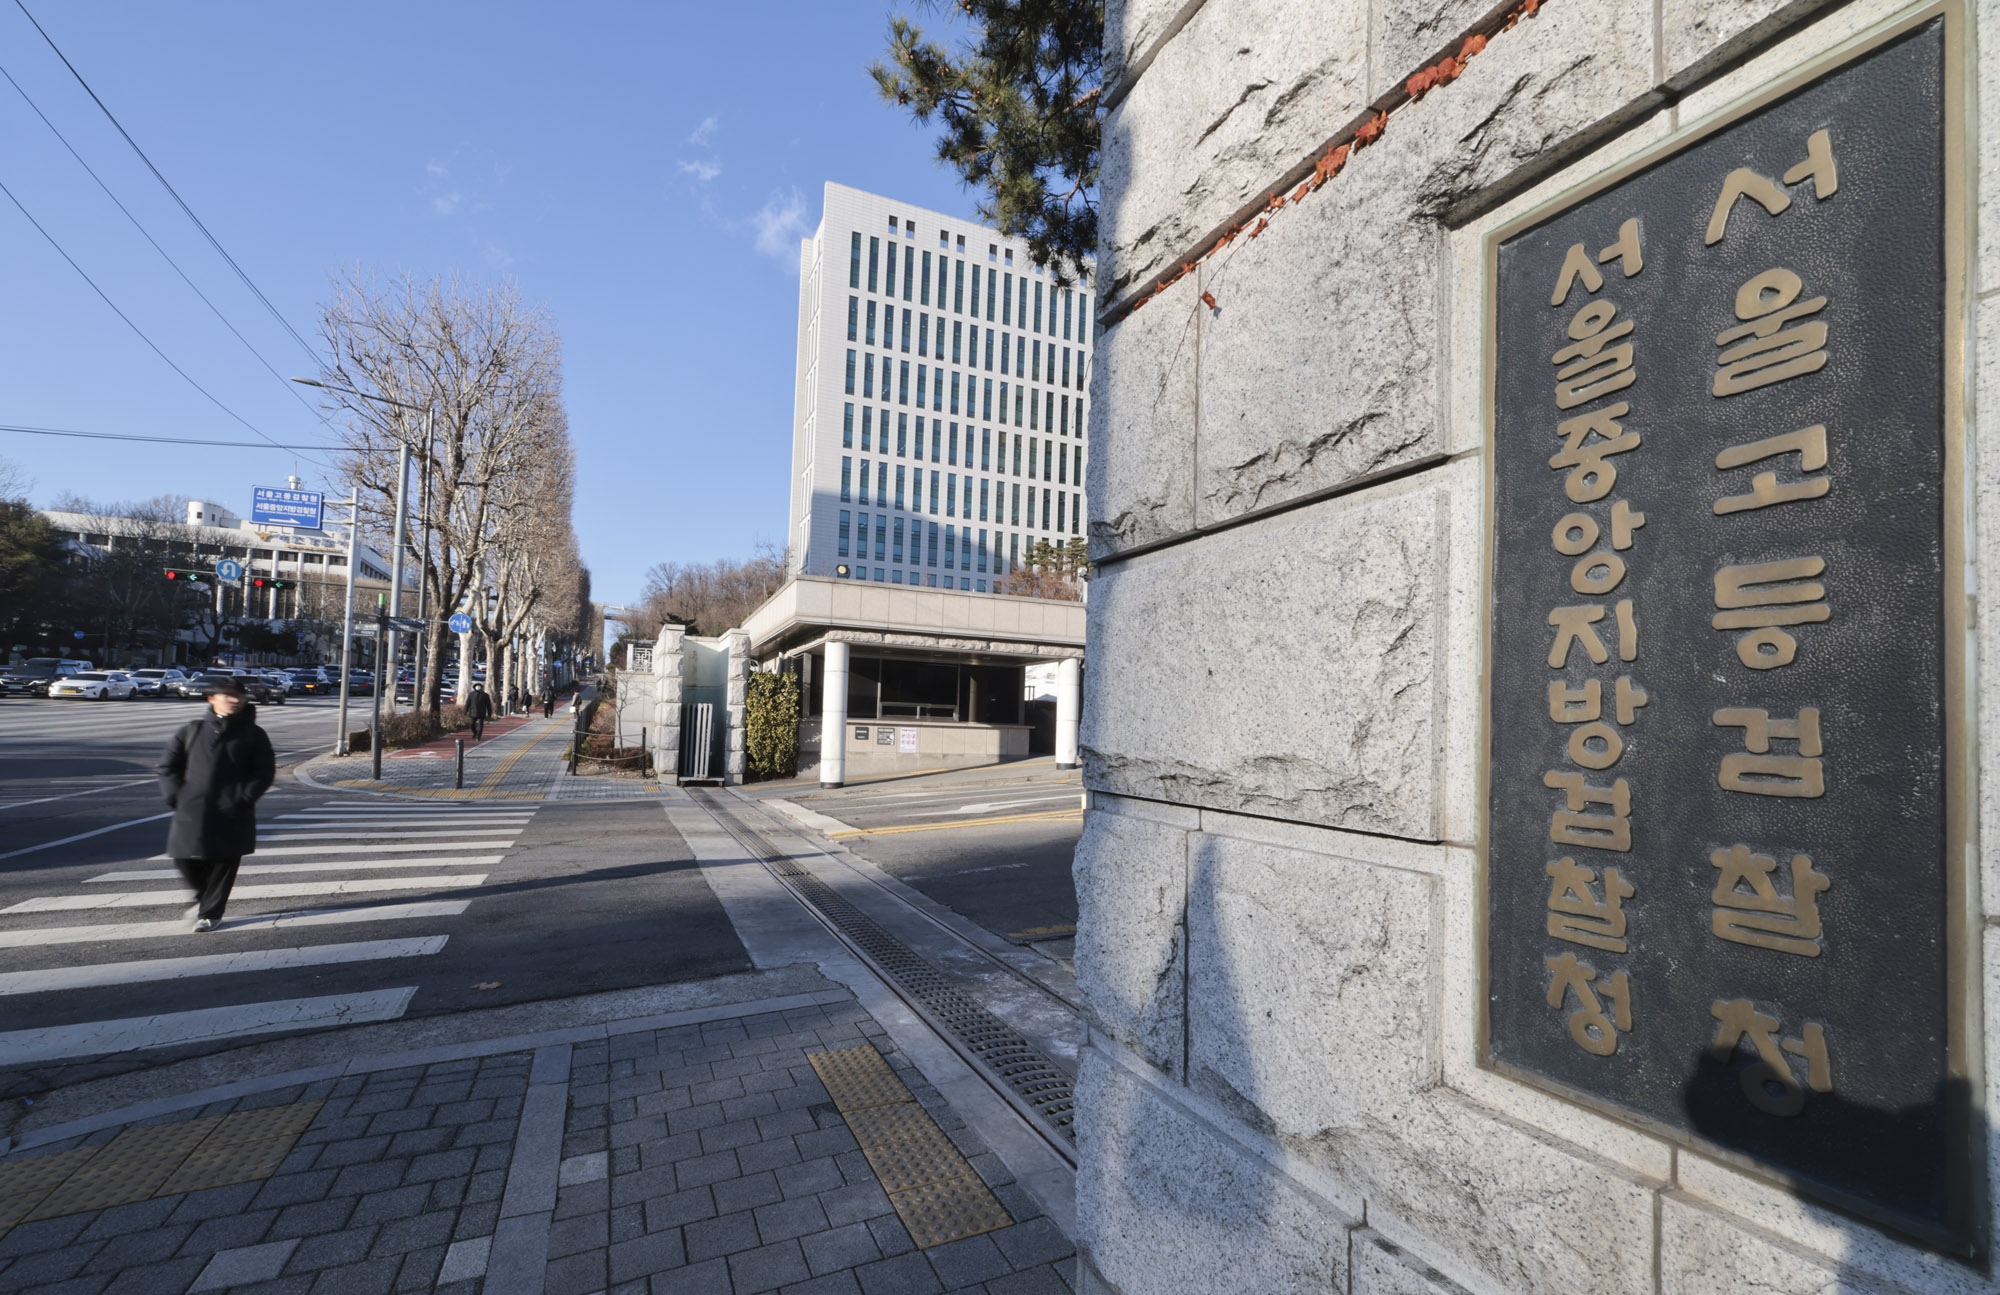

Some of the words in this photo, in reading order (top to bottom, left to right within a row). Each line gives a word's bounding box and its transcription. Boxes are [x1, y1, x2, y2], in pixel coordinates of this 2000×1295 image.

[256, 490, 318, 503] 서울고등검찰청
[1543, 216, 1648, 1057] 서울중앙지방검찰청
[1704, 128, 1839, 1118] 서울고등검찰청
